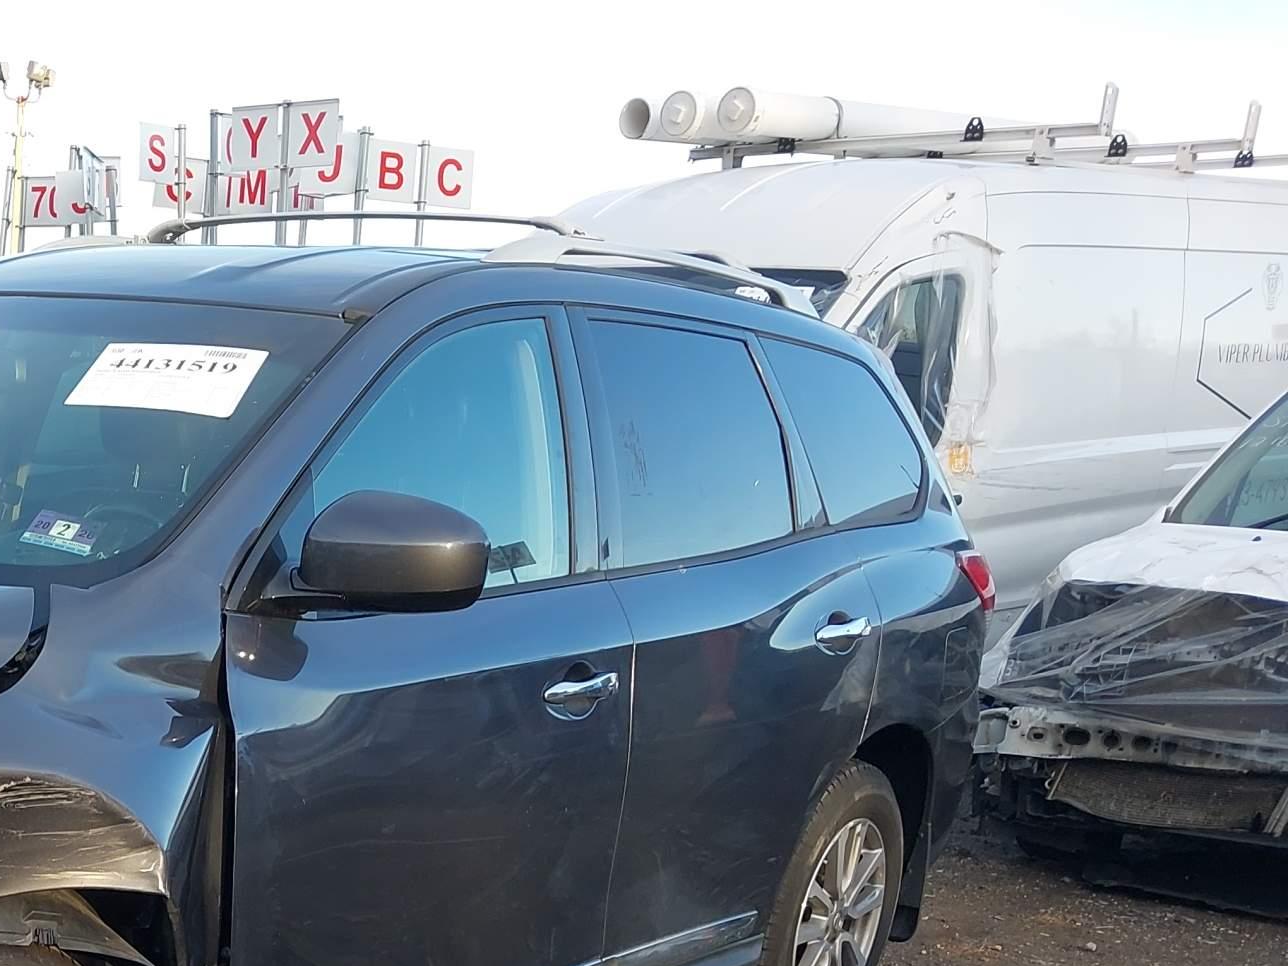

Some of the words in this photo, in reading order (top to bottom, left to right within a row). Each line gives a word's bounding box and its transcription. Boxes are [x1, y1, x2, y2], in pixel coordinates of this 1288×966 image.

[148, 134, 166, 172] S
[242, 116, 268, 158] Y
[299, 111, 327, 155] X
[318, 144, 343, 182] J
[379, 151, 403, 190] B
[438, 158, 462, 197] C
[239, 169, 267, 205] M
[110, 357, 237, 374] 44131519
[57, 524, 71, 536] 2
